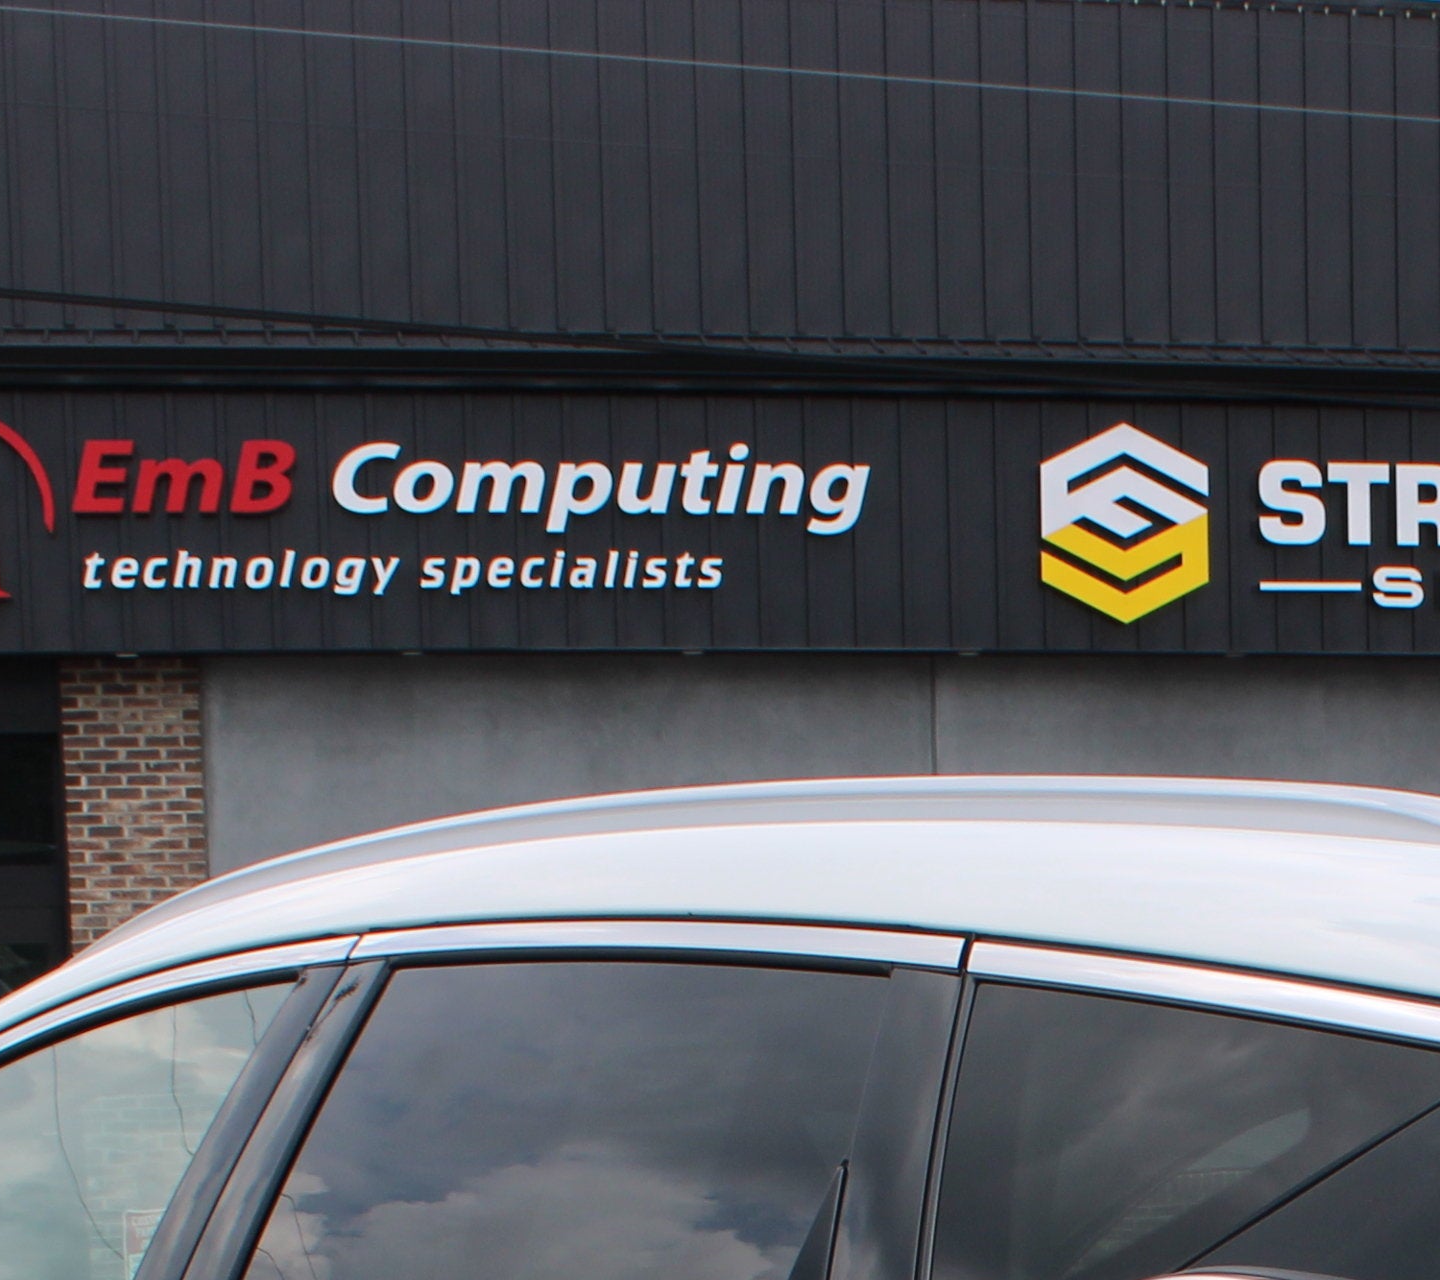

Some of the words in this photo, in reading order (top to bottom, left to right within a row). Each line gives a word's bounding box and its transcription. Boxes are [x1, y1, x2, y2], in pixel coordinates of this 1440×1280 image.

[71, 439, 296, 516] EmB
[332, 441, 871, 533] Computing
[82, 549, 400, 595] technology
[420, 550, 725, 596] specialists
